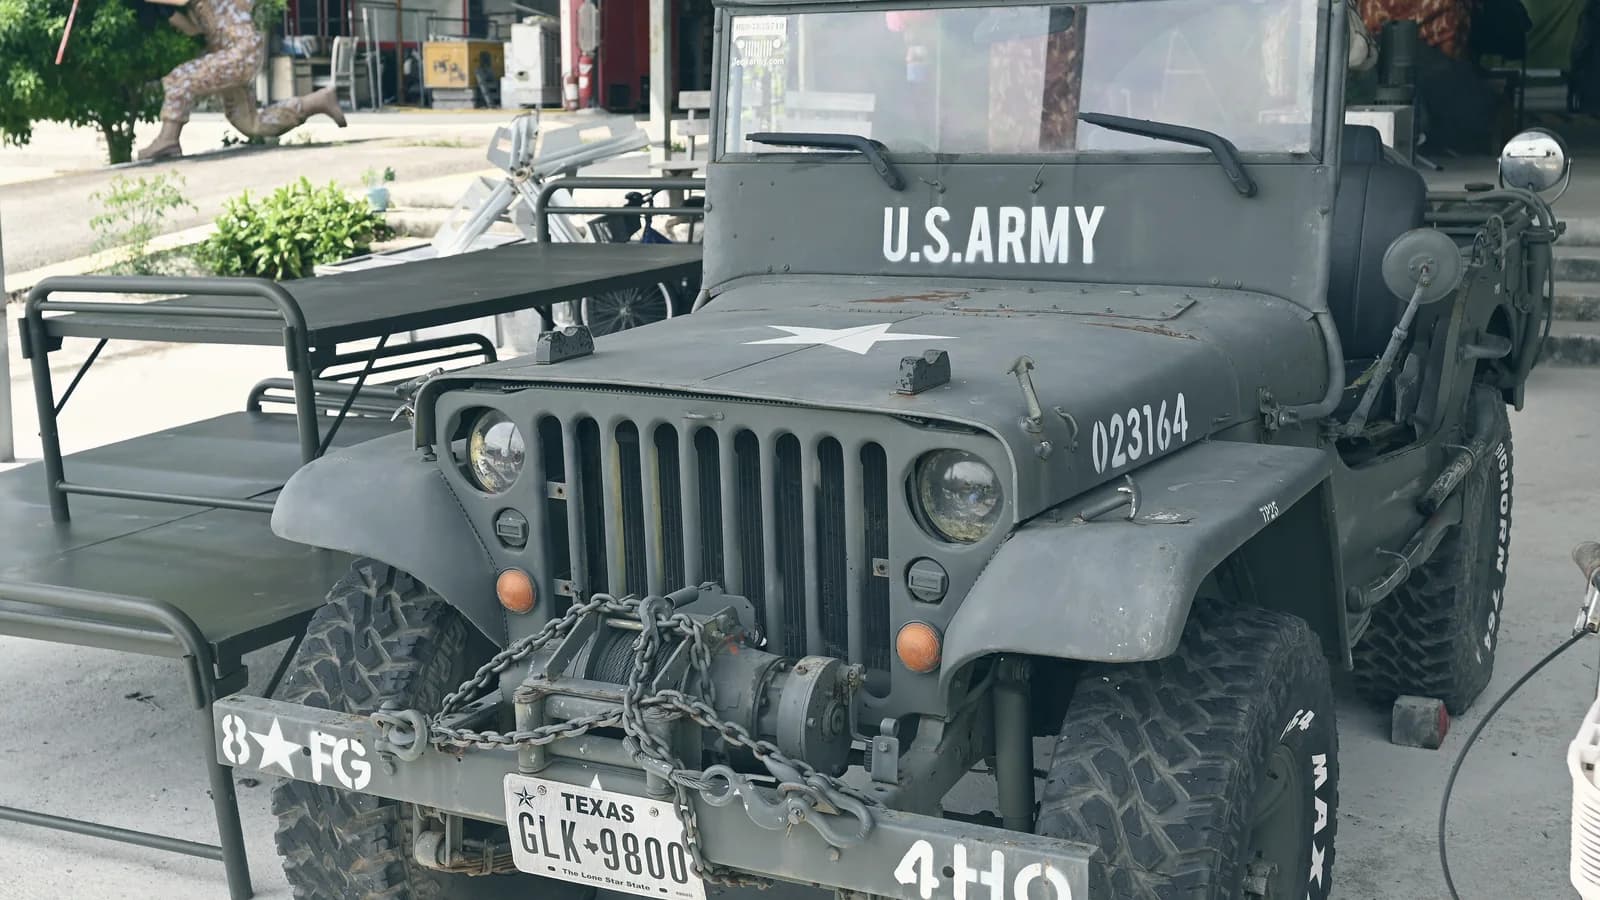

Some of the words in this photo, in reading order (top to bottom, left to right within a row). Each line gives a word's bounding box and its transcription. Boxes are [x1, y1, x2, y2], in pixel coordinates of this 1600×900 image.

[1091, 392, 1189, 475] 023164
[221, 713, 250, 766] 8
[309, 729, 372, 791] FG
[560, 791, 635, 824] TEXAS
[561, 867, 579, 878] The
[581, 871, 603, 882] Lone
[604, 876, 624, 887] Star
[626, 880, 651, 892] State
